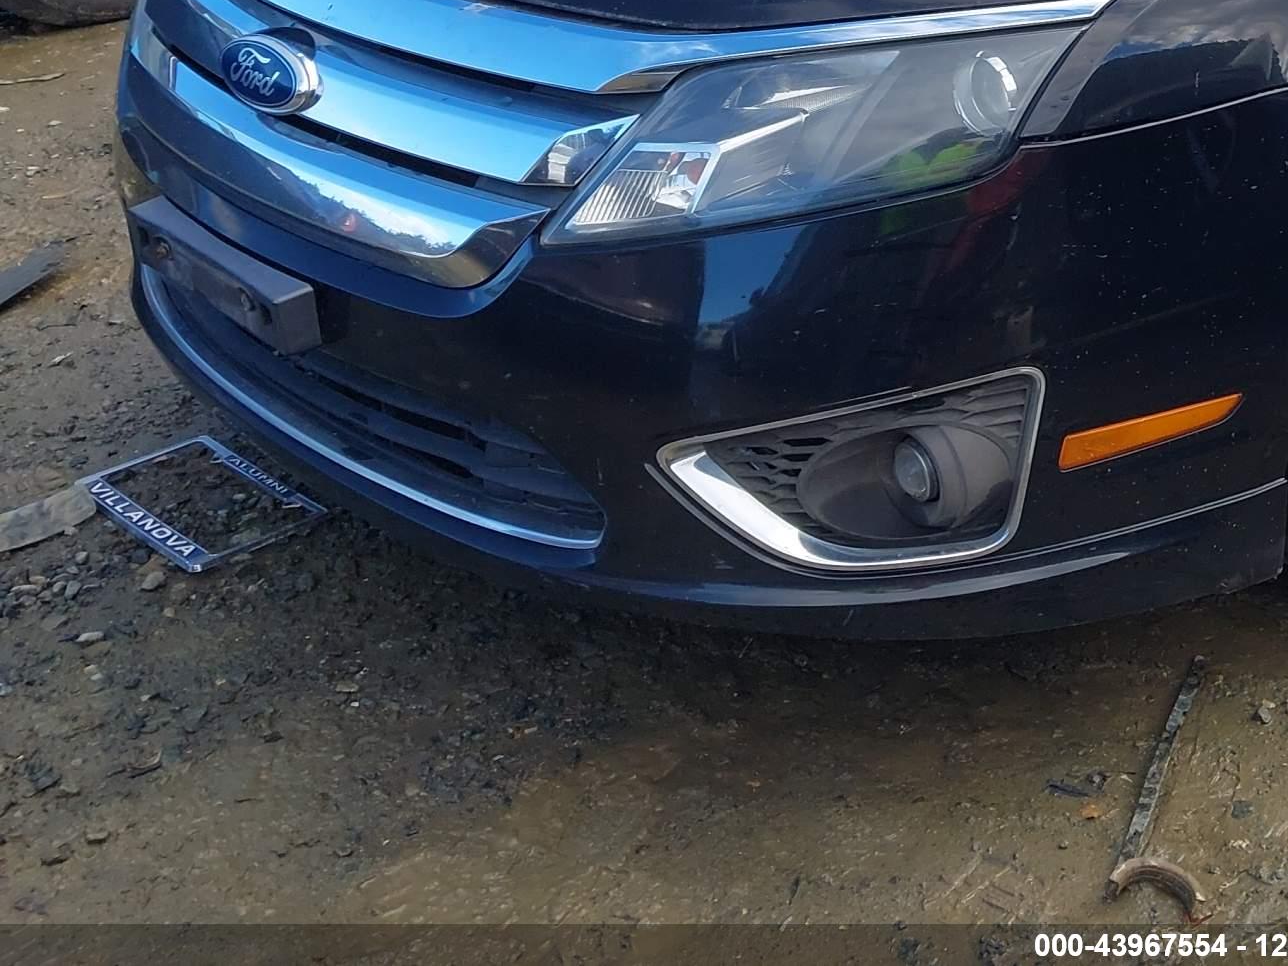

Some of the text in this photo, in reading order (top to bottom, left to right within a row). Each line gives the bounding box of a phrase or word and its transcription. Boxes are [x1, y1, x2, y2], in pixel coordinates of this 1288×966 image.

[230, 47, 281, 97] Ford
[228, 455, 289, 495] ALUMNI
[89, 481, 198, 558] VILLANOVA
